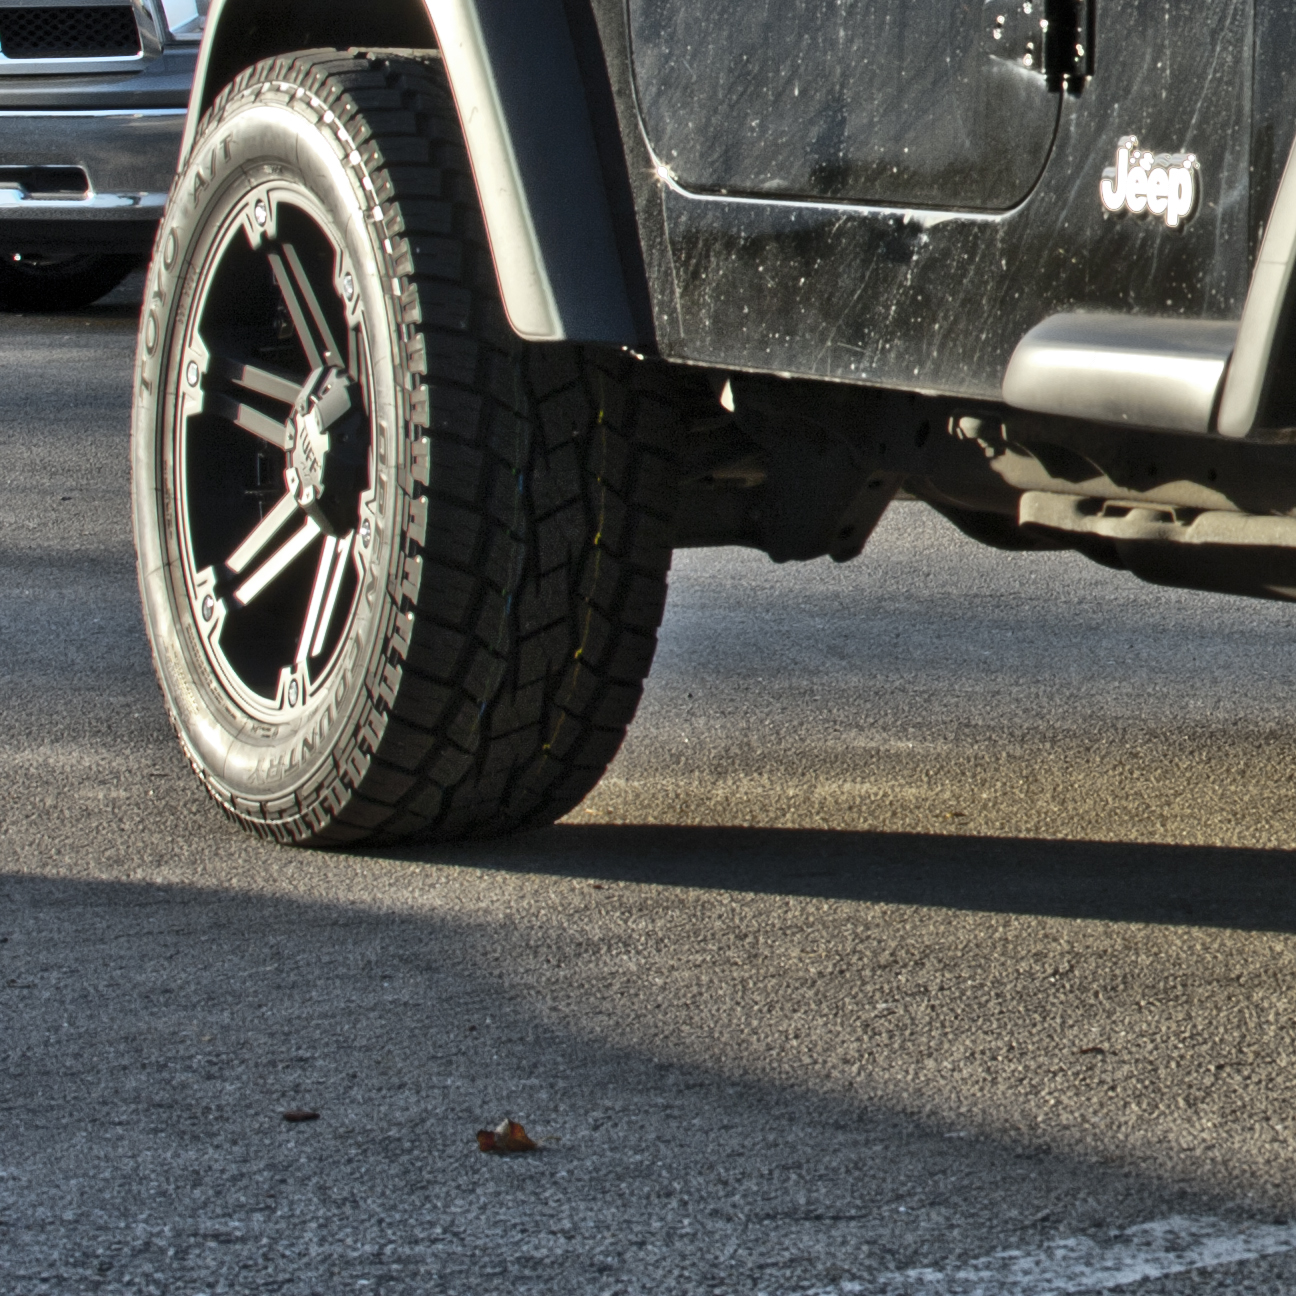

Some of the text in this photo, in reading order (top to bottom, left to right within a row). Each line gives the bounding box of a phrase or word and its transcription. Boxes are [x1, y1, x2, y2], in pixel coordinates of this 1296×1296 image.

[140, 131, 235, 401] TOYO A/T
[1100, 138, 1198, 228] Jeep
